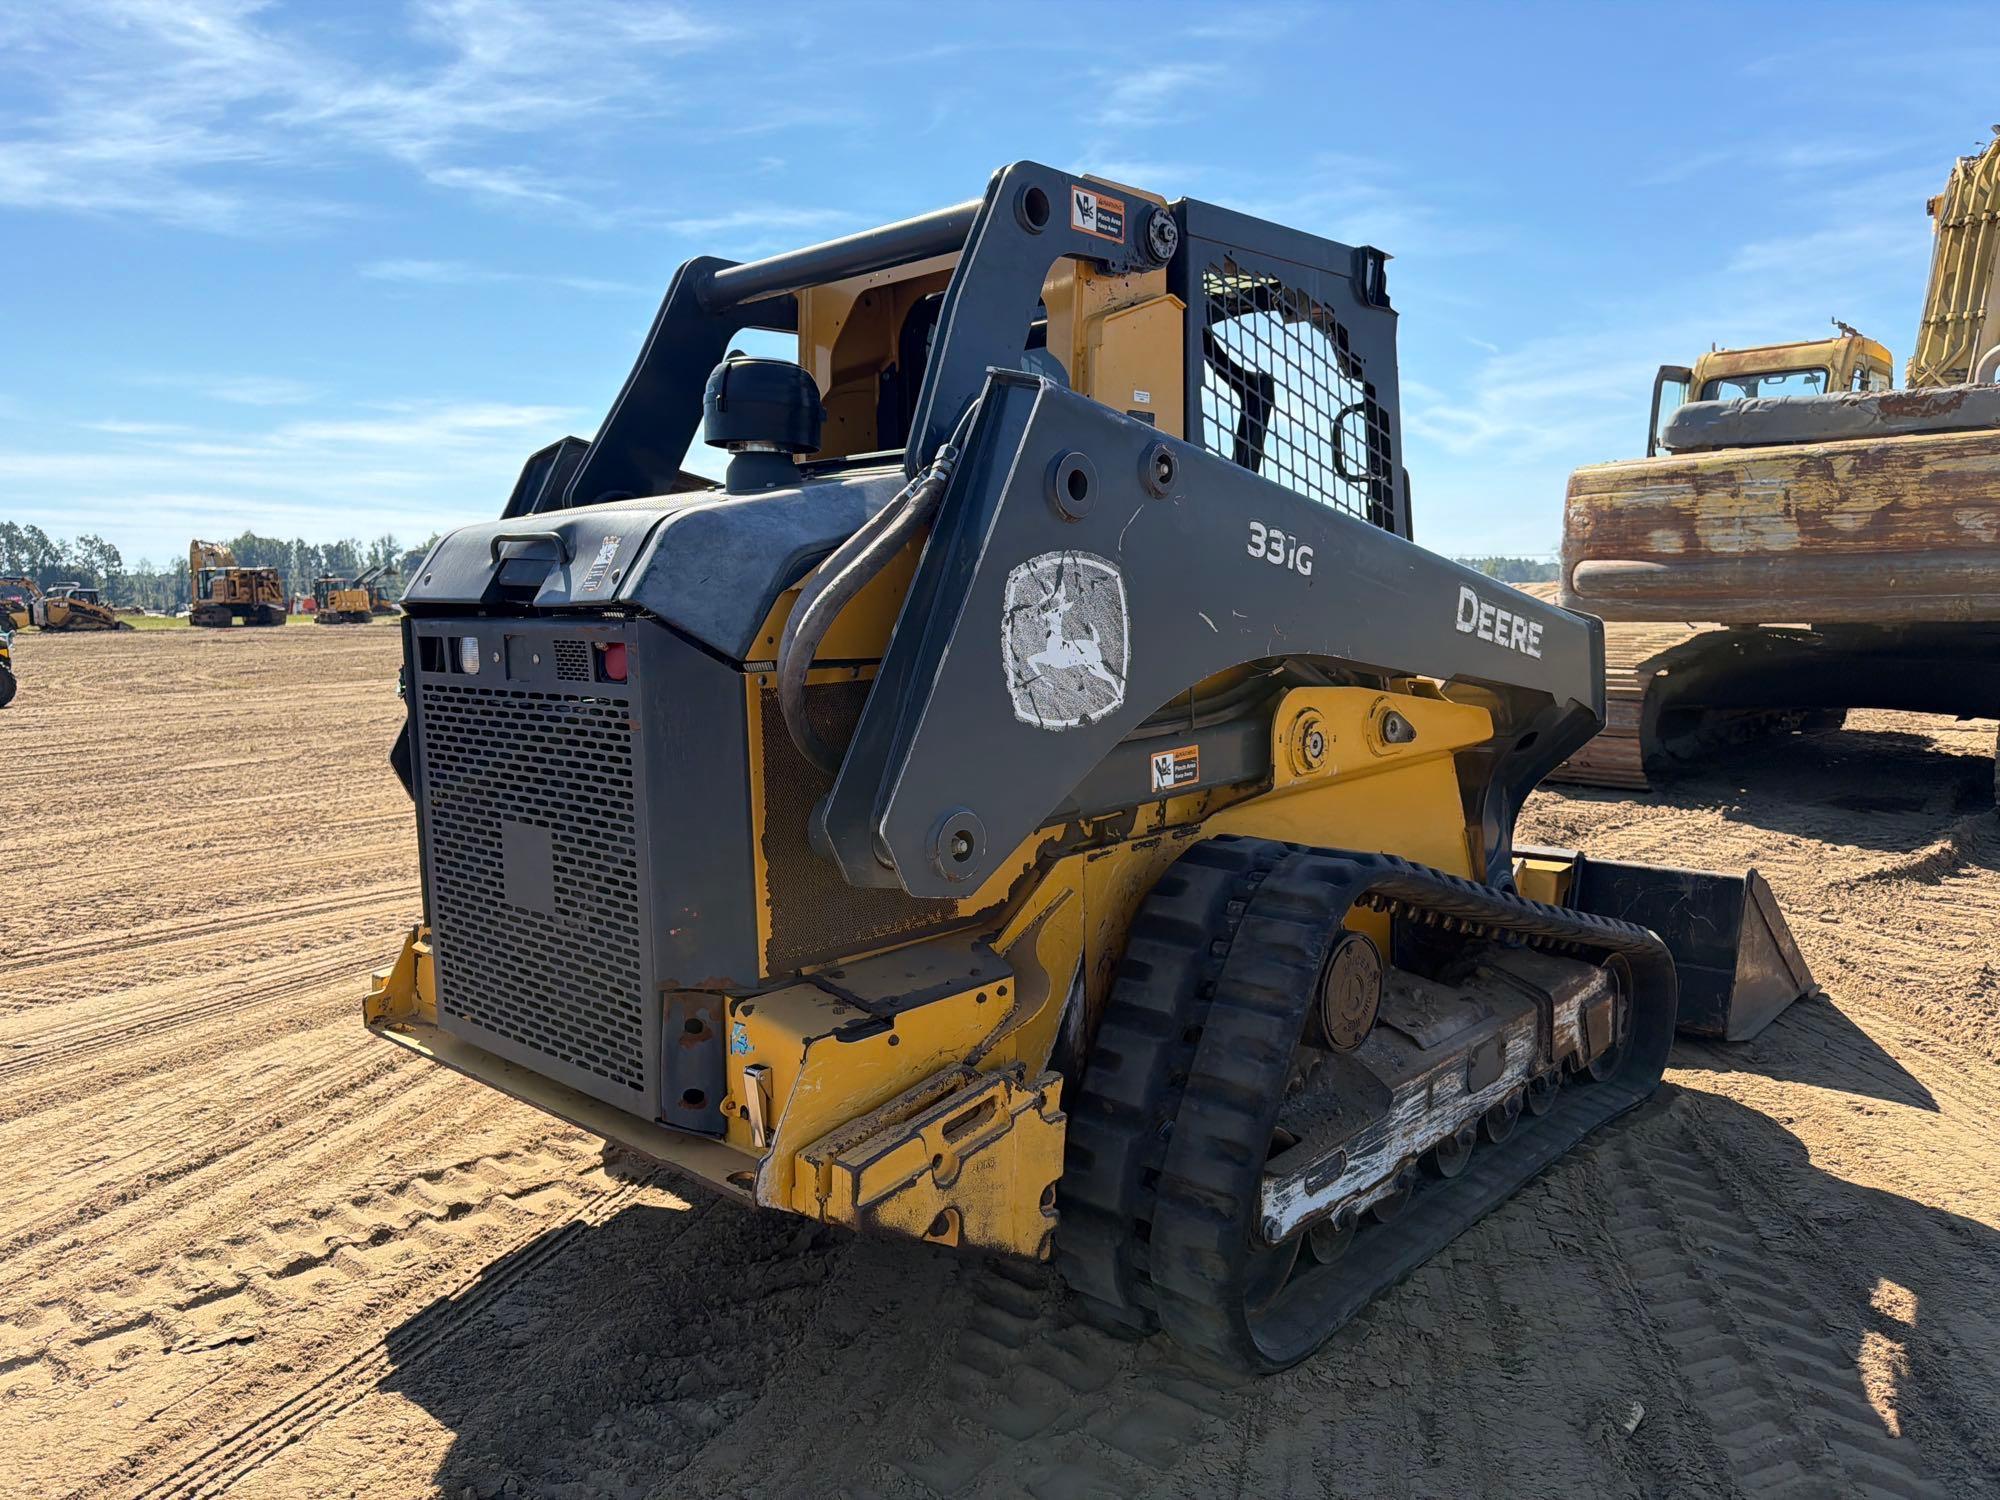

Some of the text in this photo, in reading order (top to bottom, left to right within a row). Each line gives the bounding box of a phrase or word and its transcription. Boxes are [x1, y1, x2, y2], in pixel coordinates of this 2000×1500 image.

[1111, 216, 1121, 226] Area
[1248, 521, 1313, 576] 331G
[1456, 586, 1543, 658] DEERE
